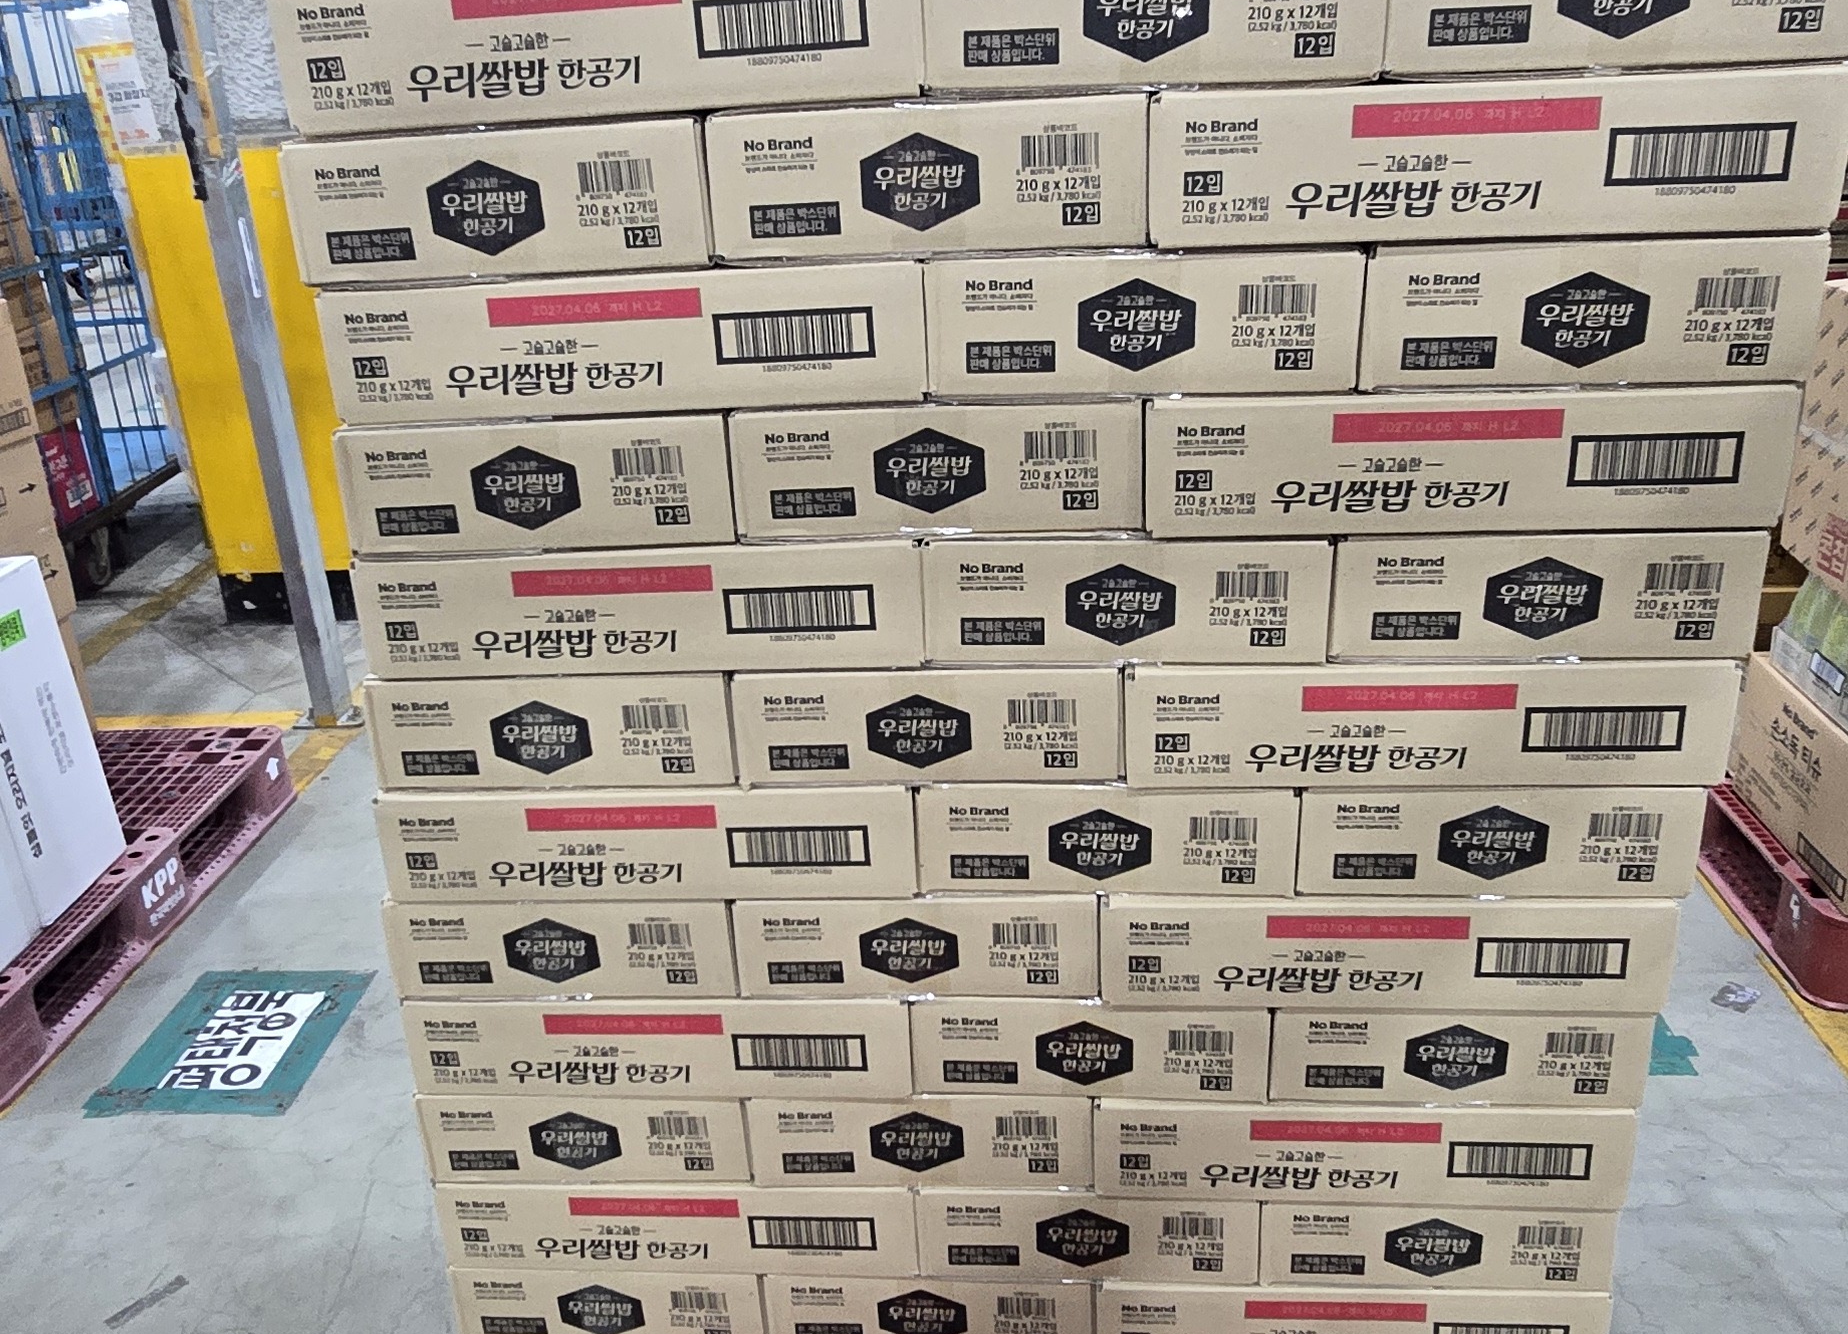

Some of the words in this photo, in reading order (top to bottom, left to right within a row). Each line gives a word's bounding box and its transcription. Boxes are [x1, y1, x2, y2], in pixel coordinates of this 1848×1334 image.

[297, 9, 318, 21] No
[320, 3, 365, 20] Brand
[1784, 8, 1822, 31] 12입
[407, 57, 550, 102] 우리쌀밥
[557, 55, 641, 89] 한공기
[1186, 121, 1207, 133] No
[1211, 118, 1258, 133] Brand
[744, 140, 764, 152] No
[767, 136, 812, 150] Brand
[873, 163, 966, 191] 우리쌀밥
[1187, 173, 1221, 193] 12입
[441, 190, 529, 217] 우리쌀밥
[894, 191, 947, 211] 한공기
[1182, 200, 1205, 213] 210
[1208, 202, 1217, 214] g
[1231, 196, 1270, 211] 12개입
[1286, 179, 1443, 220] 우리쌀밥
[1451, 180, 1542, 212] 한공기
[463, 217, 513, 237] 한공기
[1407, 275, 1429, 286] No
[1432, 272, 1480, 286] Brand
[1536, 303, 1635, 329] 우리쌀밥
[1555, 329, 1611, 348] 한공기
[1278, 350, 1312, 370] 12입
[446, 361, 578, 398] 우리쌀밥
[585, 360, 663, 389] 한공기
[1177, 426, 1197, 437] No
[1200, 424, 1245, 437] Brand
[886, 455, 973, 479] 우리쌀밥
[905, 479, 955, 496] 한공기
[1271, 479, 1417, 513] 우리쌀밥
[1425, 481, 1509, 508] 한공기
[1077, 591, 1163, 613] 우리쌀밥
[1095, 612, 1145, 629] 한공기
[1680, 622, 1713, 640] 12입
[472, 628, 597, 659] 우리쌀밥
[603, 629, 676, 654] 한공기
[664, 757, 695, 773] 12입
[1245, 744, 1381, 773] 우리쌀밥
[1388, 746, 1467, 770] 한공기
[1450, 830, 1536, 851] 우리쌀밥
[1467, 850, 1516, 865] 한공기
[141, 857, 178, 909] KPP
[488, 861, 607, 887] 우리쌀밥
[613, 862, 682, 884] 한공기
[1213, 966, 1342, 993] 우리쌀밥
[1349, 970, 1424, 991] 한공기
[508, 1061, 620, 1085] 우리쌀밥
[625, 1064, 690, 1083] 한공기
